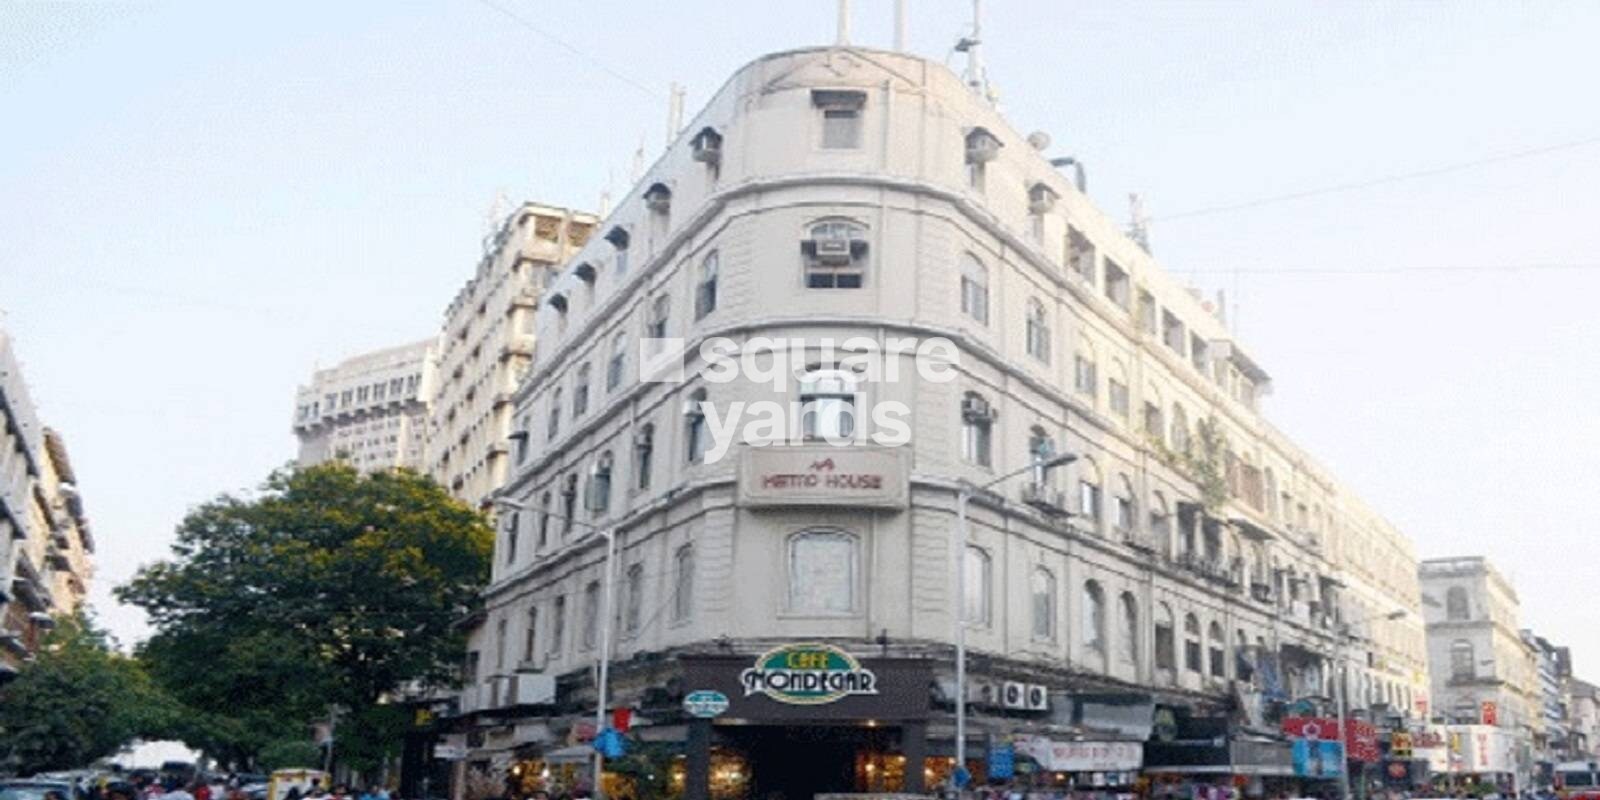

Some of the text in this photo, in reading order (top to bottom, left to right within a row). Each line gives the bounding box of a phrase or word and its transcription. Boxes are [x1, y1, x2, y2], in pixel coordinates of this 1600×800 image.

[761, 474, 882, 490] METRO HOUSE
[743, 671, 874, 691] MONDEGAR
